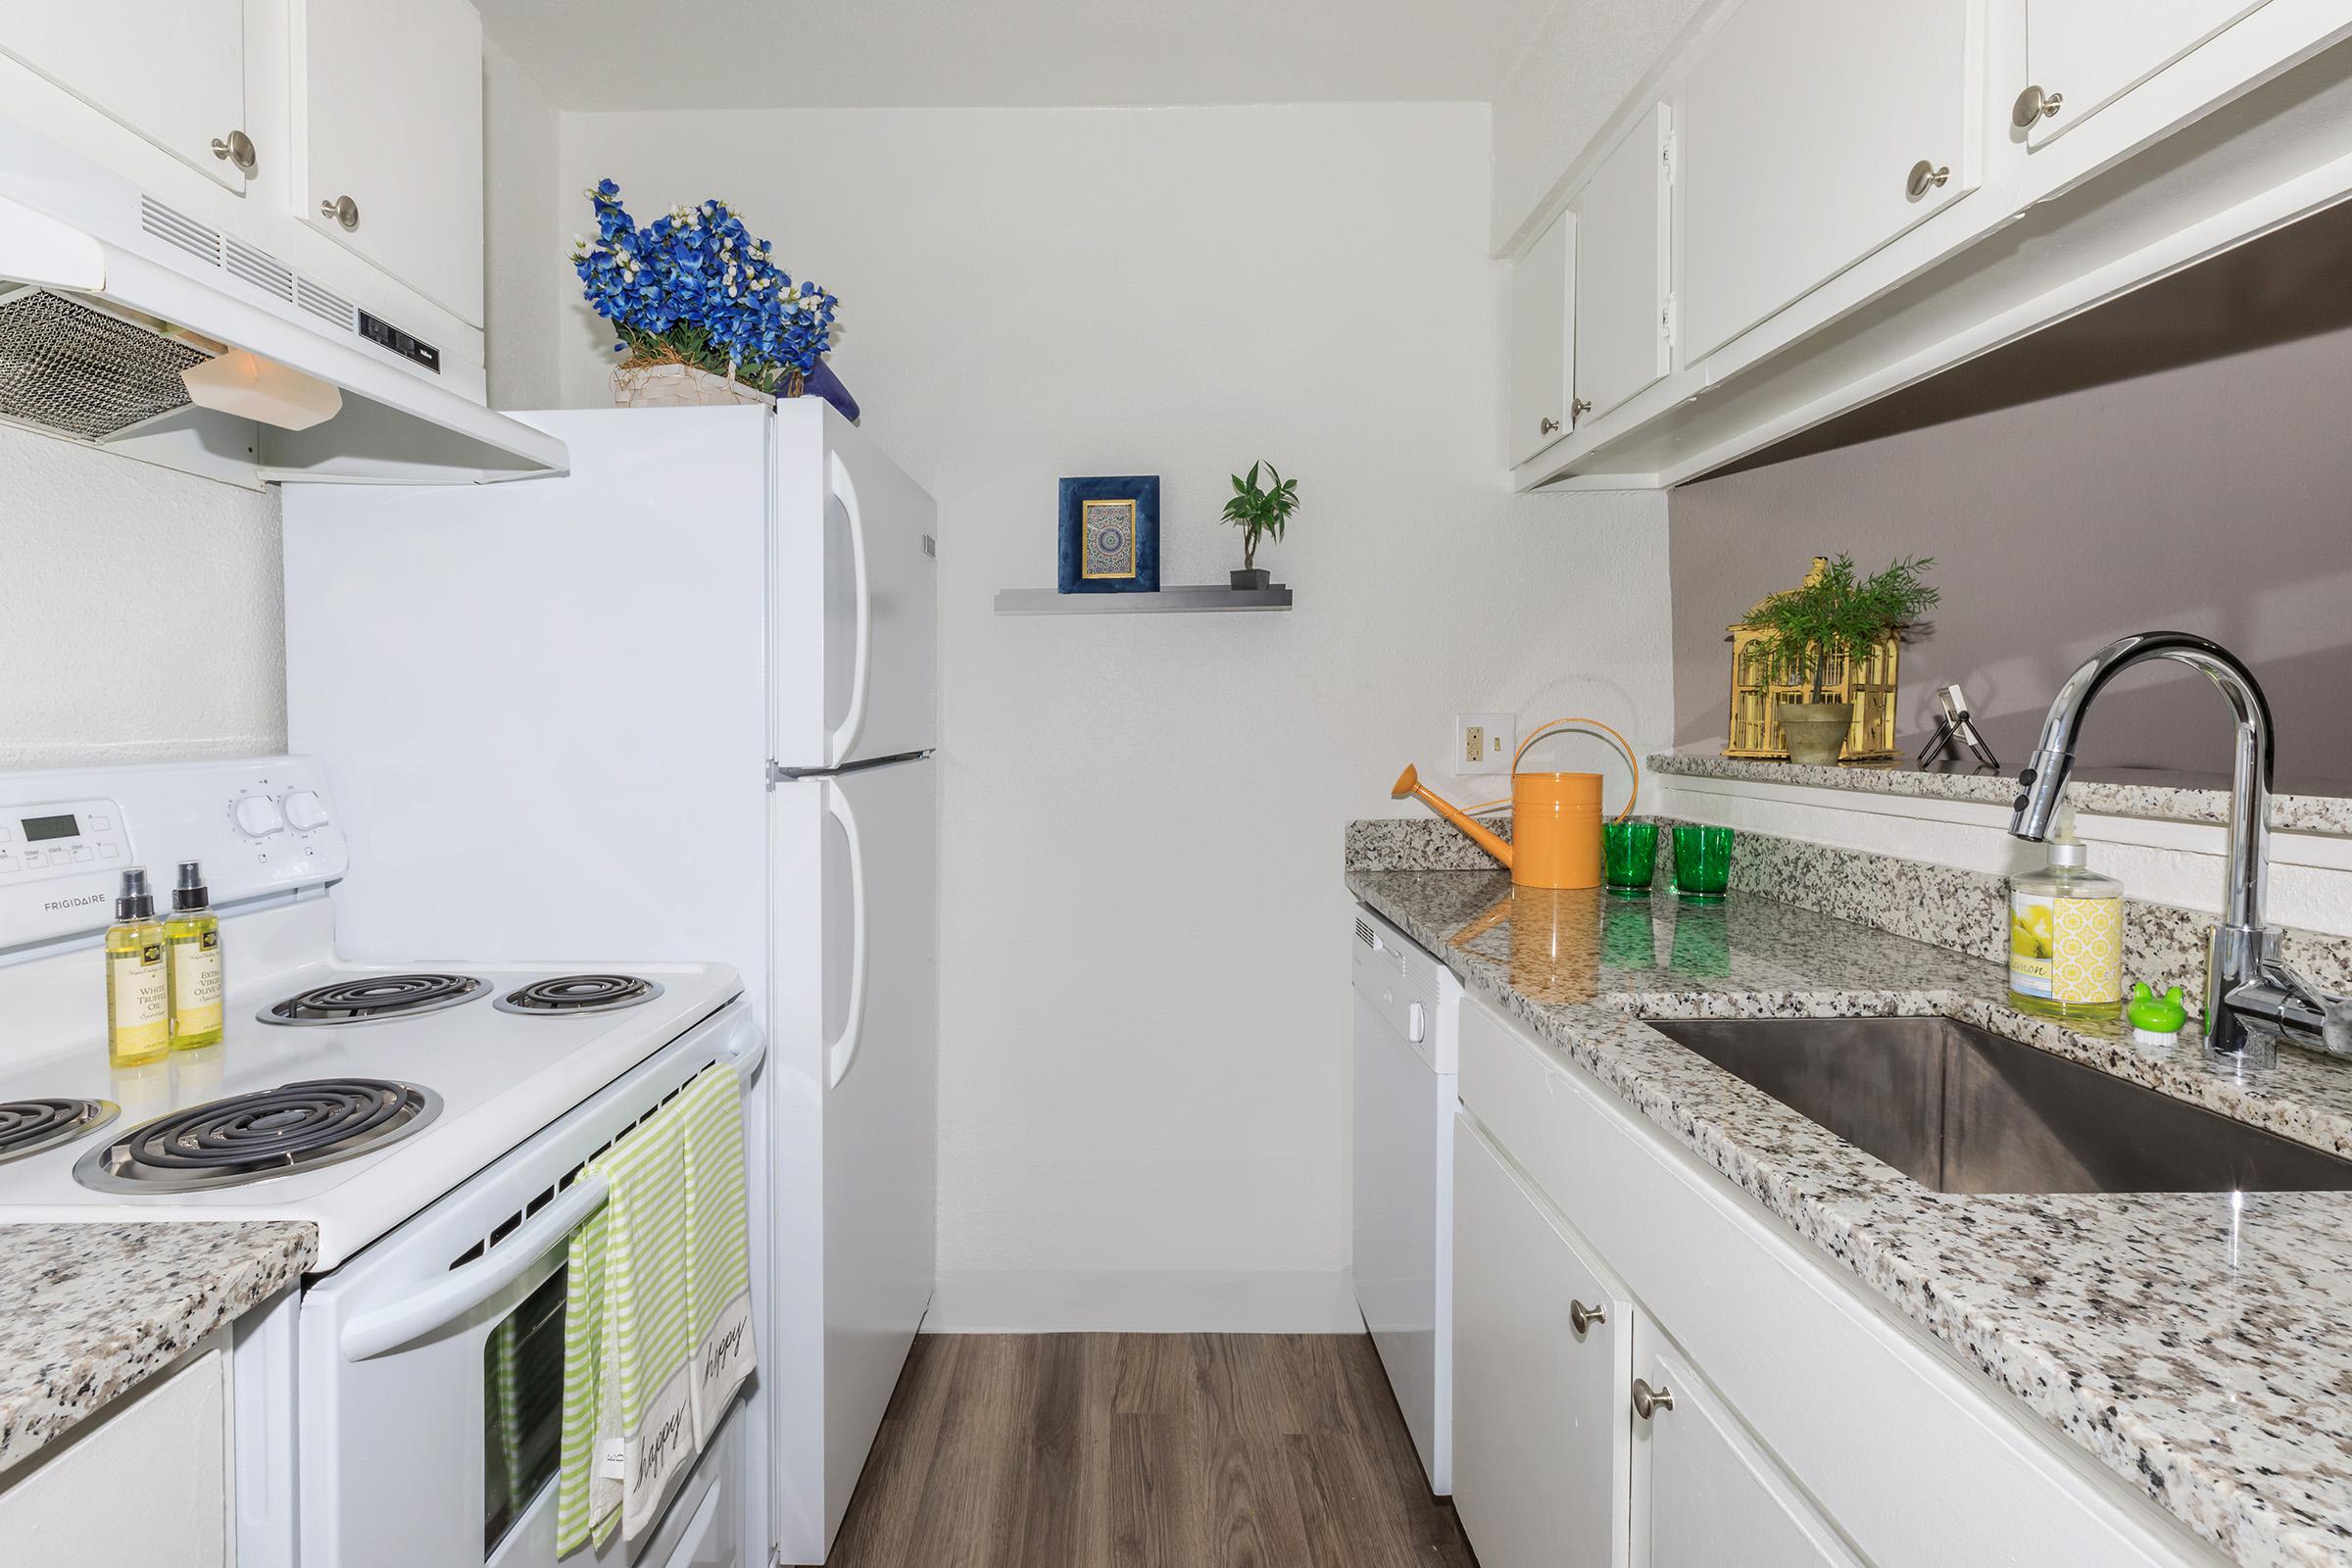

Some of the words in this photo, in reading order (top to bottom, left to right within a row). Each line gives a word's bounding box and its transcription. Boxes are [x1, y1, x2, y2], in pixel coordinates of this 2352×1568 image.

[44, 894, 106, 912] FRIGIDAIRE
[139, 984, 166, 996] WHITE
[147, 1003, 161, 1011] OIL
[703, 1315, 748, 1391] hppy
[633, 1398, 687, 1494] happy
